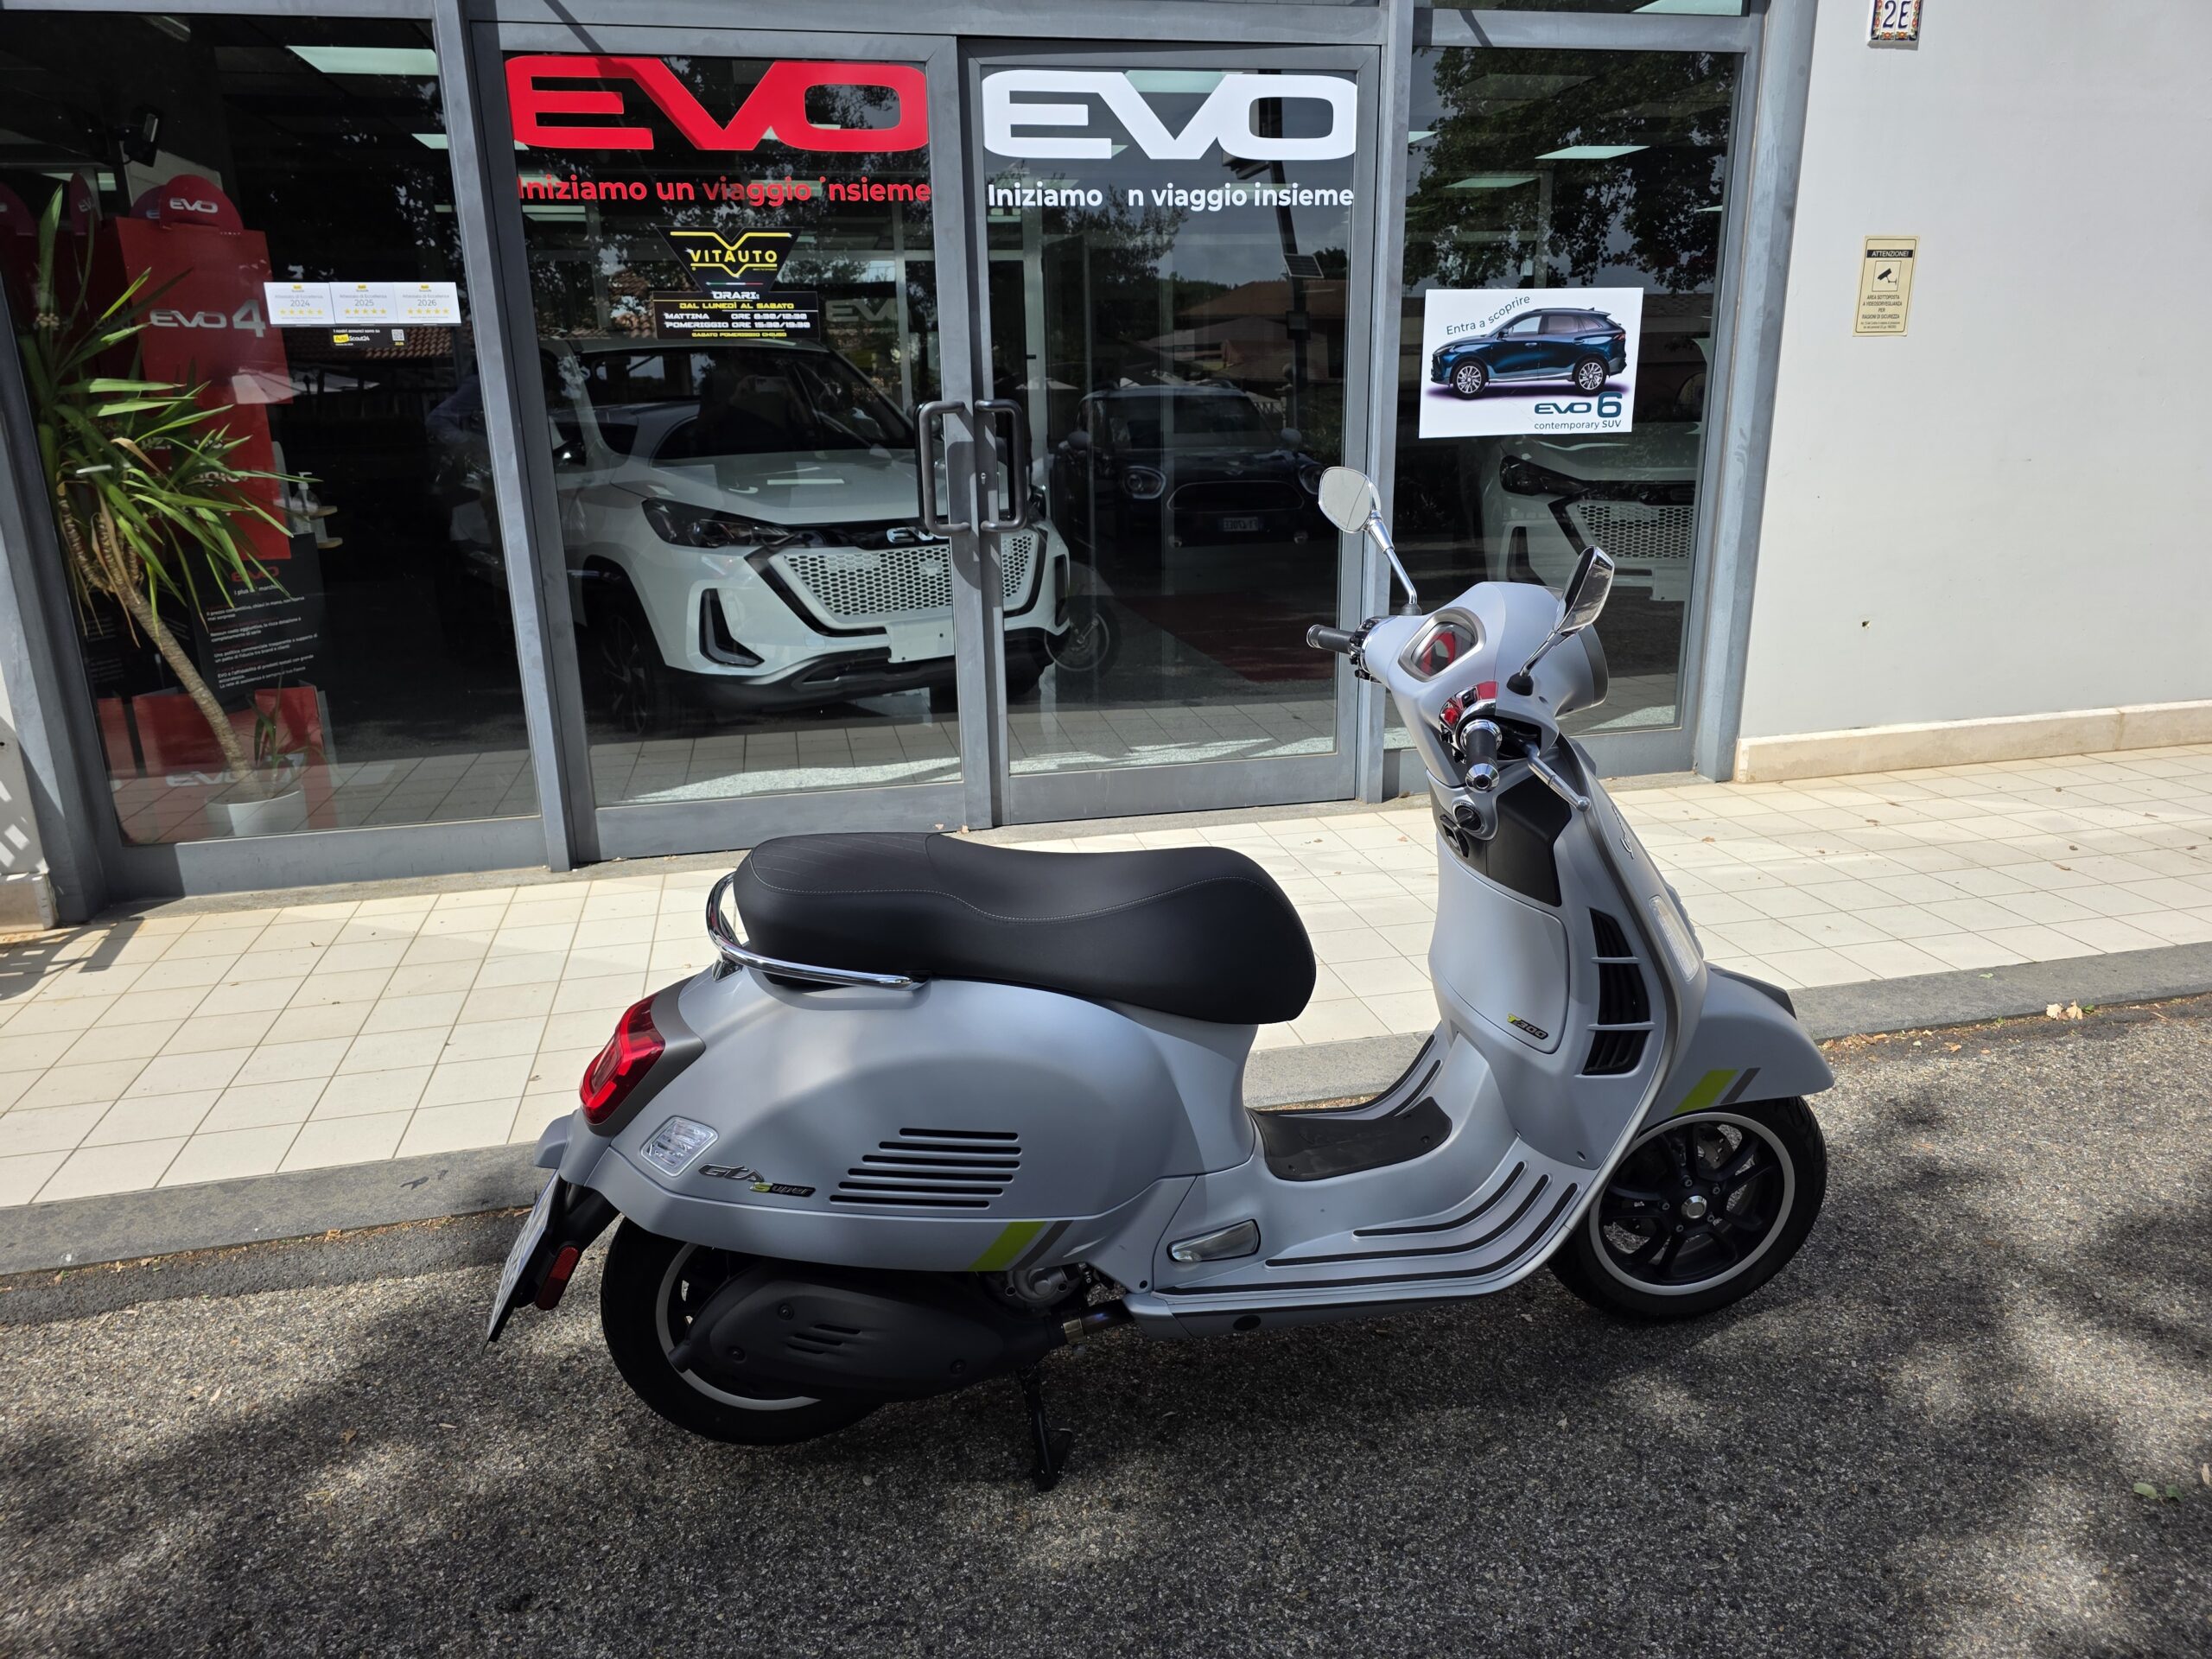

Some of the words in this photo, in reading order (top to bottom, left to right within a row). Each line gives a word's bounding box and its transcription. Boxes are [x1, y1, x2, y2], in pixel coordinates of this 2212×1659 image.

[1882, 0, 1911, 29] 2E
[505, 55, 929, 152] EVO
[982, 69, 1357, 161] EVO
[169, 197, 218, 213] EVO
[518, 174, 647, 200] Iniziamo
[656, 182, 695, 200] un
[702, 175, 811, 207] viaggio
[821, 175, 931, 201] nsieme
[988, 181, 1103, 207] Iniziamo
[1151, 182, 1247, 212] viaggio
[1255, 181, 1354, 207] insieme
[690, 249, 778, 263] VITAUTO
[712, 291, 760, 300] ORARI:
[150, 310, 226, 328] EVO
[232, 300, 266, 338] 4
[1446, 322, 1476, 334] Entra
[1488, 296, 1530, 323] scoprire
[1535, 402, 1592, 414] EVO
[1597, 391, 1623, 418] 6
[1534, 422, 1600, 430] contemporary
[887, 525, 950, 543] EV
